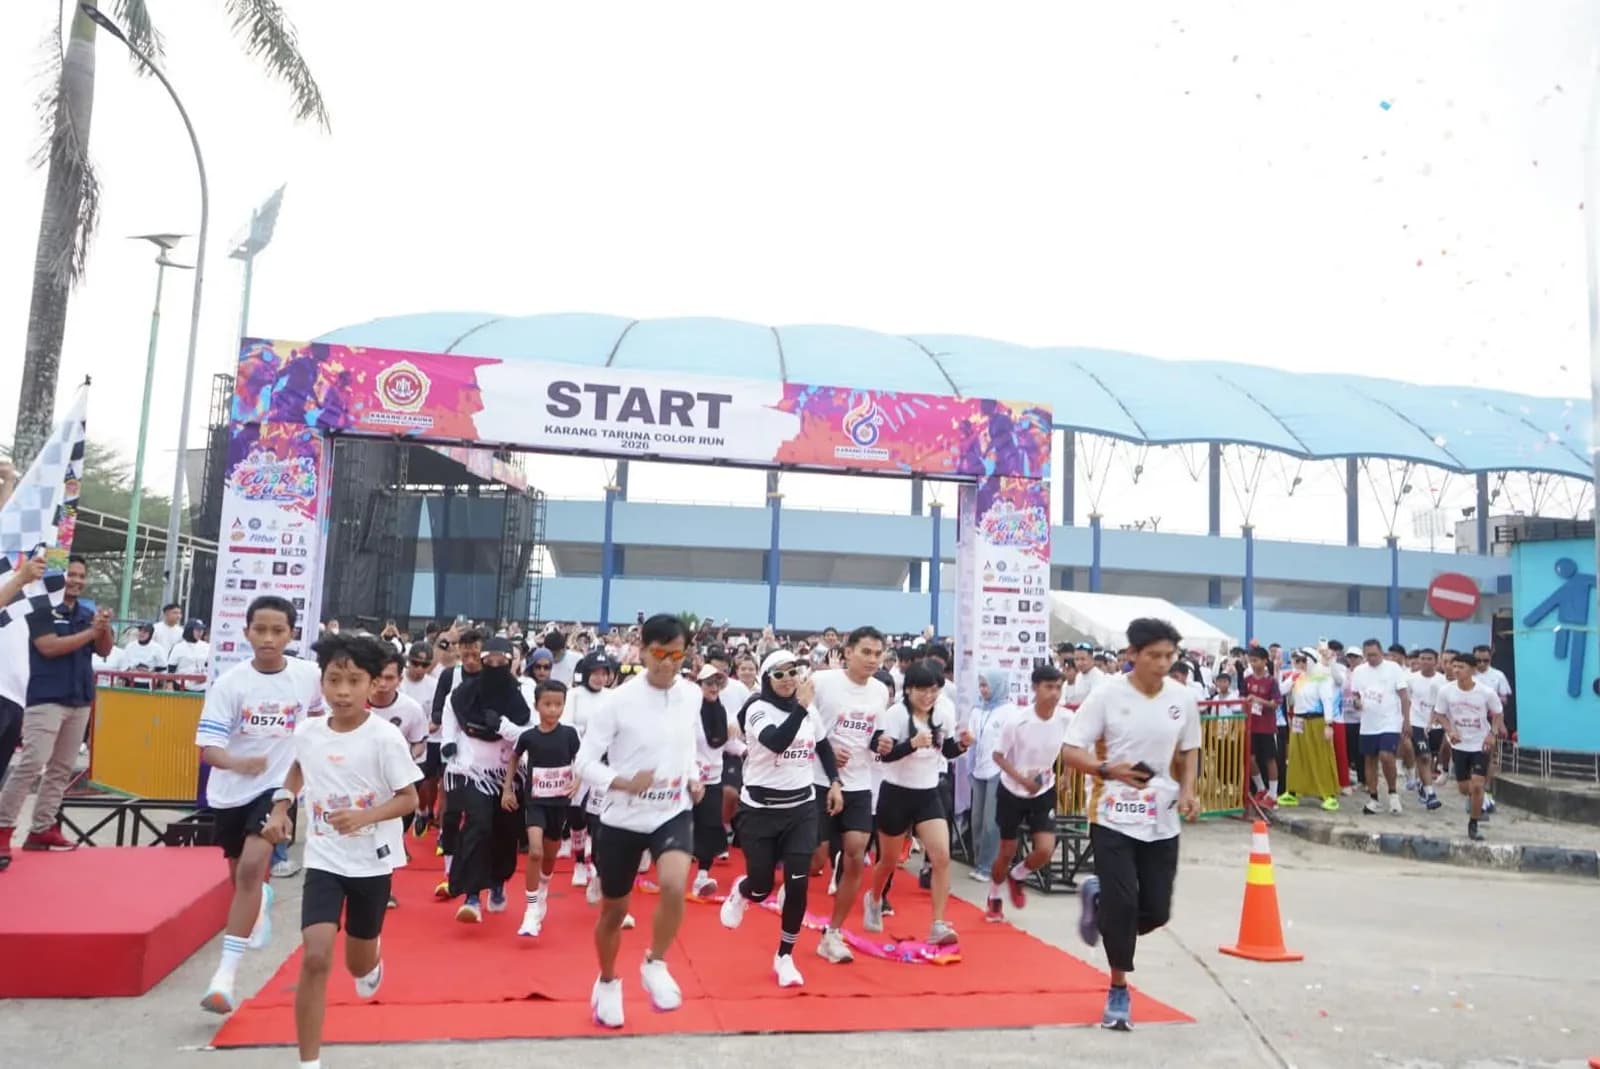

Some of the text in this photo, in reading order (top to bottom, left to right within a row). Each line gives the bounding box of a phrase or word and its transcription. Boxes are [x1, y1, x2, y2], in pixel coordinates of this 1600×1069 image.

[545, 380, 733, 429] START
[545, 424, 725, 446] KARANG TARUNA COLOR RUN
[621, 439, 650, 450] 2026
[251, 715, 285, 726] 0574
[843, 720, 867, 730] 0382
[783, 749, 808, 759] 0675
[1115, 802, 1146, 813] 0108
